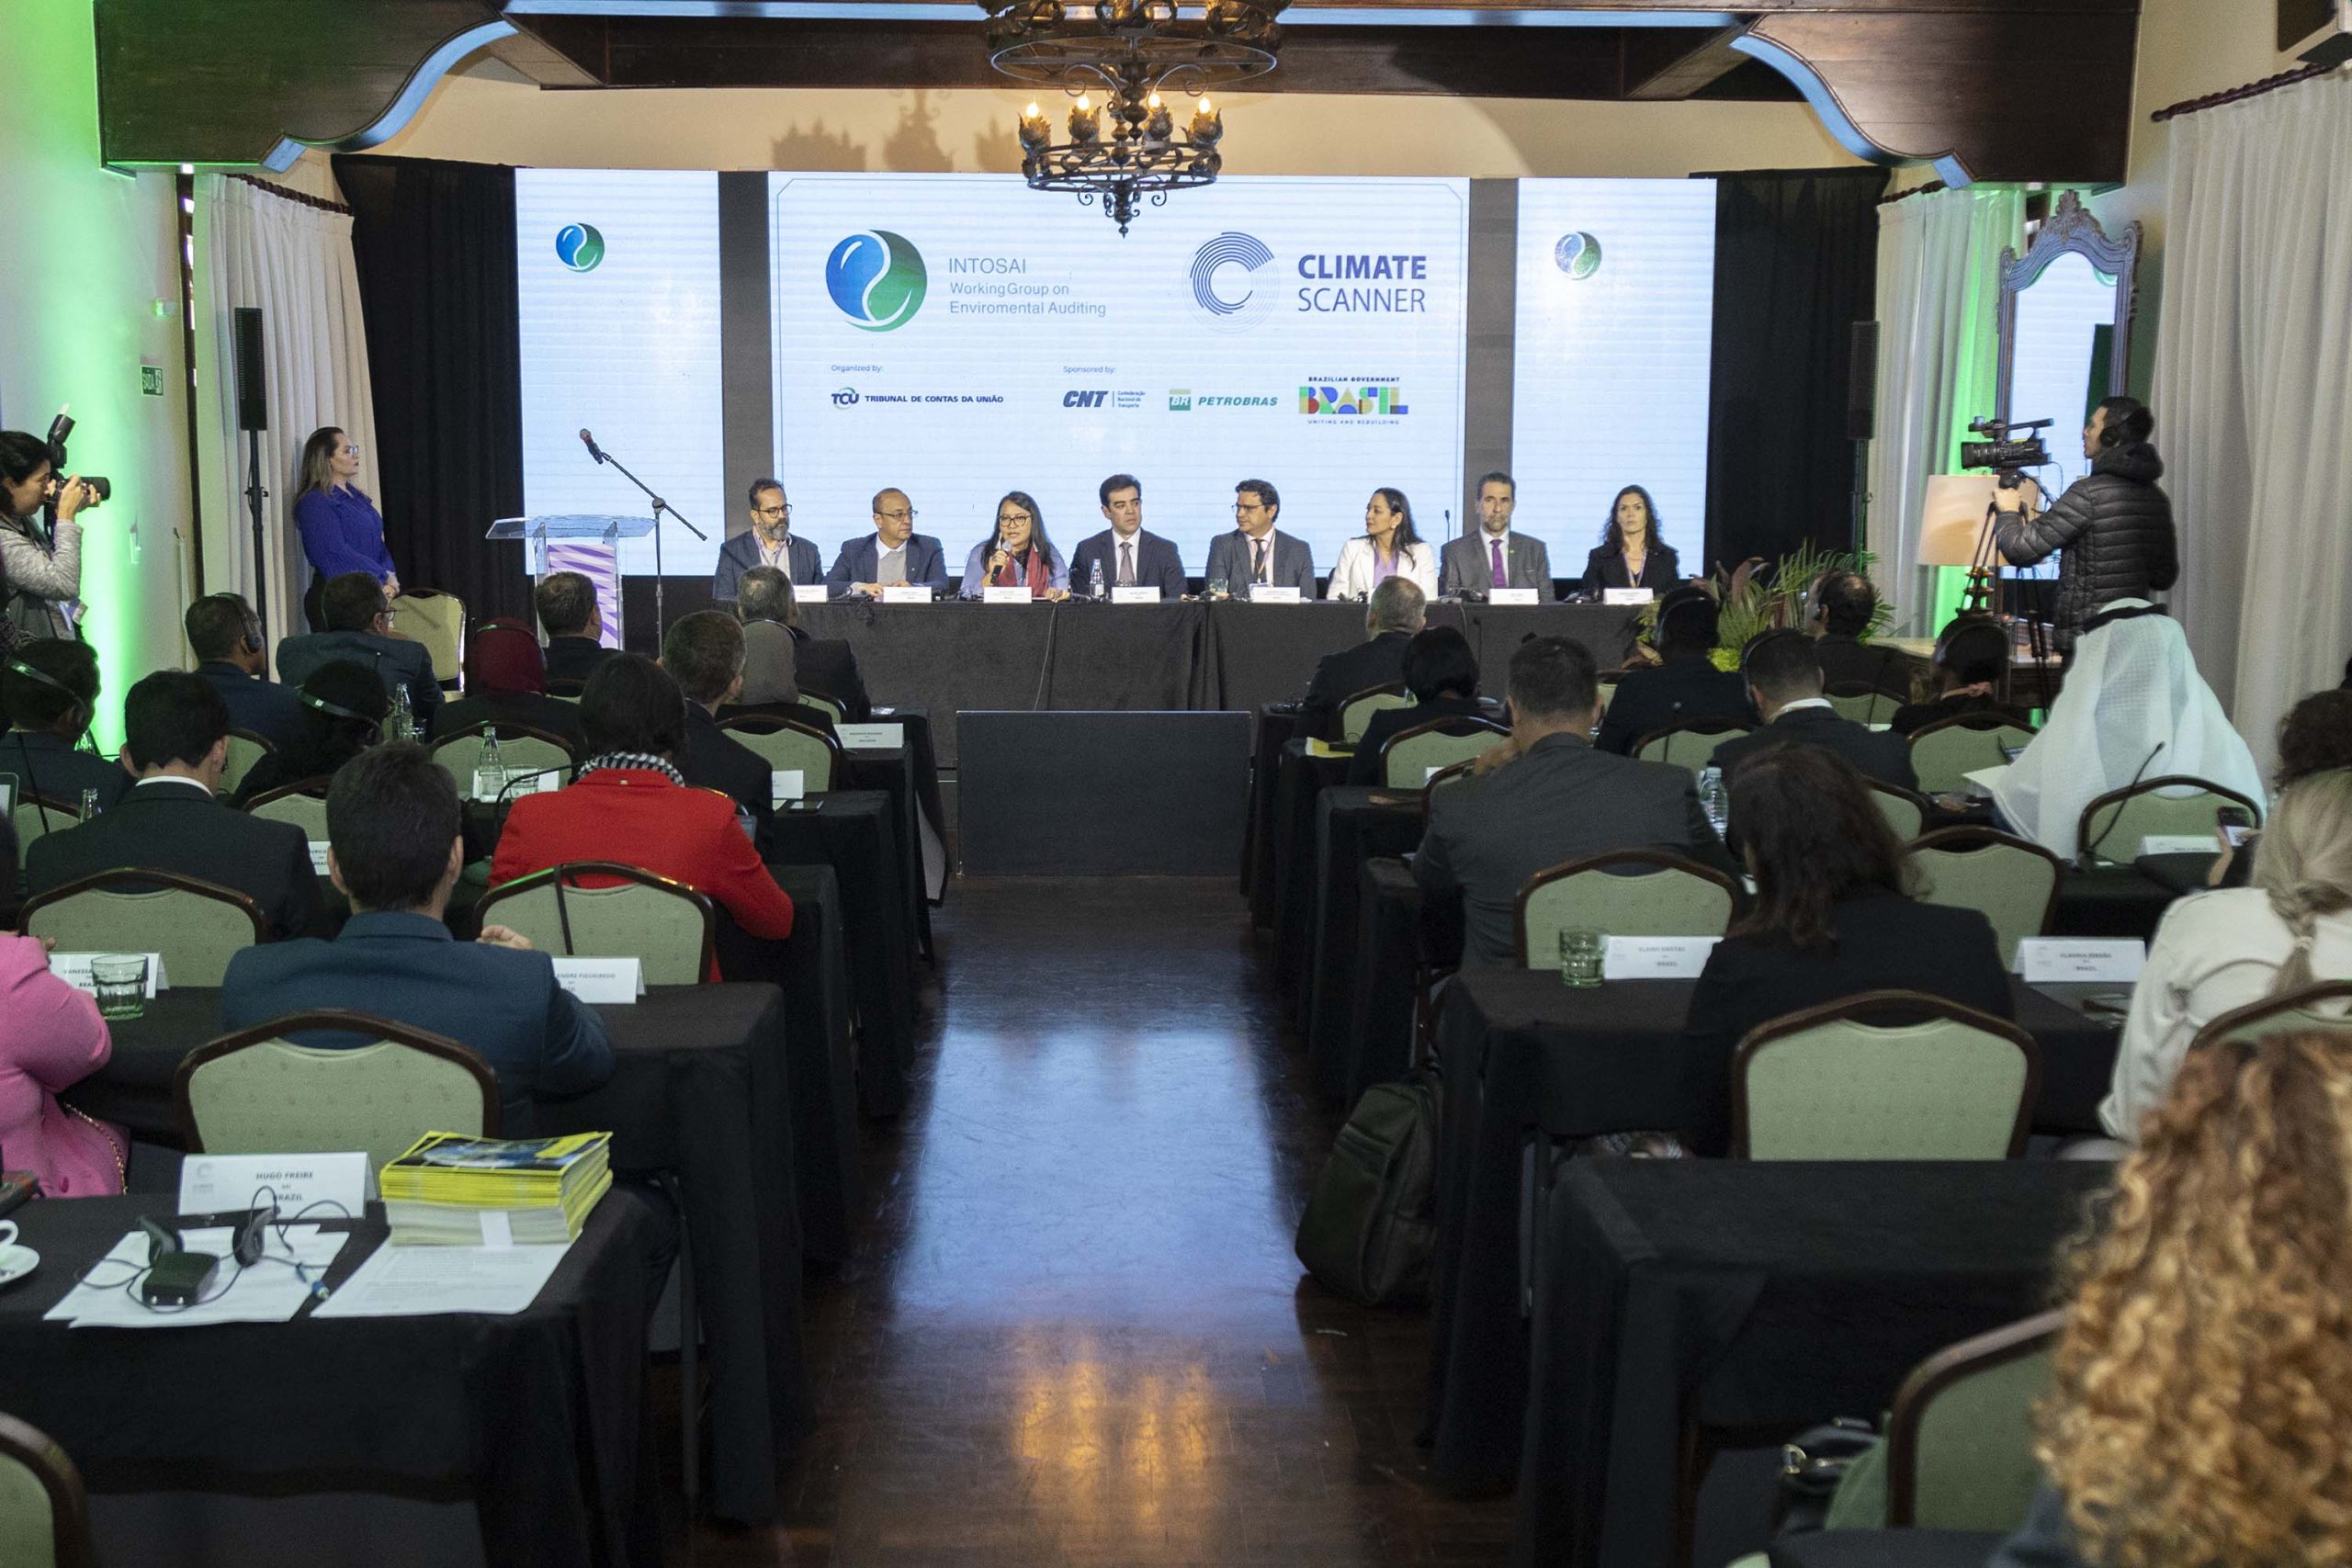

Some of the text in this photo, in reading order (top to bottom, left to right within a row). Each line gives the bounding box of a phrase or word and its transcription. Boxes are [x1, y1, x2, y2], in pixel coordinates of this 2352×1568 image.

[949, 258, 1026, 274] INTOSAI
[1298, 255, 1426, 279] CLIMATE
[950, 282, 1069, 298] Working Group on
[1298, 288, 1426, 312] SCANNER
[950, 301, 1106, 317] Enviromental Auditing
[831, 364, 871, 373] Organized
[1063, 365, 1103, 375] Sponsored
[831, 393, 859, 405] TCU
[976, 394, 1004, 403] UNIÃO
[1063, 390, 1109, 408] CNT
[1171, 397, 1189, 406] BR
[1198, 396, 1278, 406] PETROBRAS
[1299, 386, 1408, 414] BRASIL
